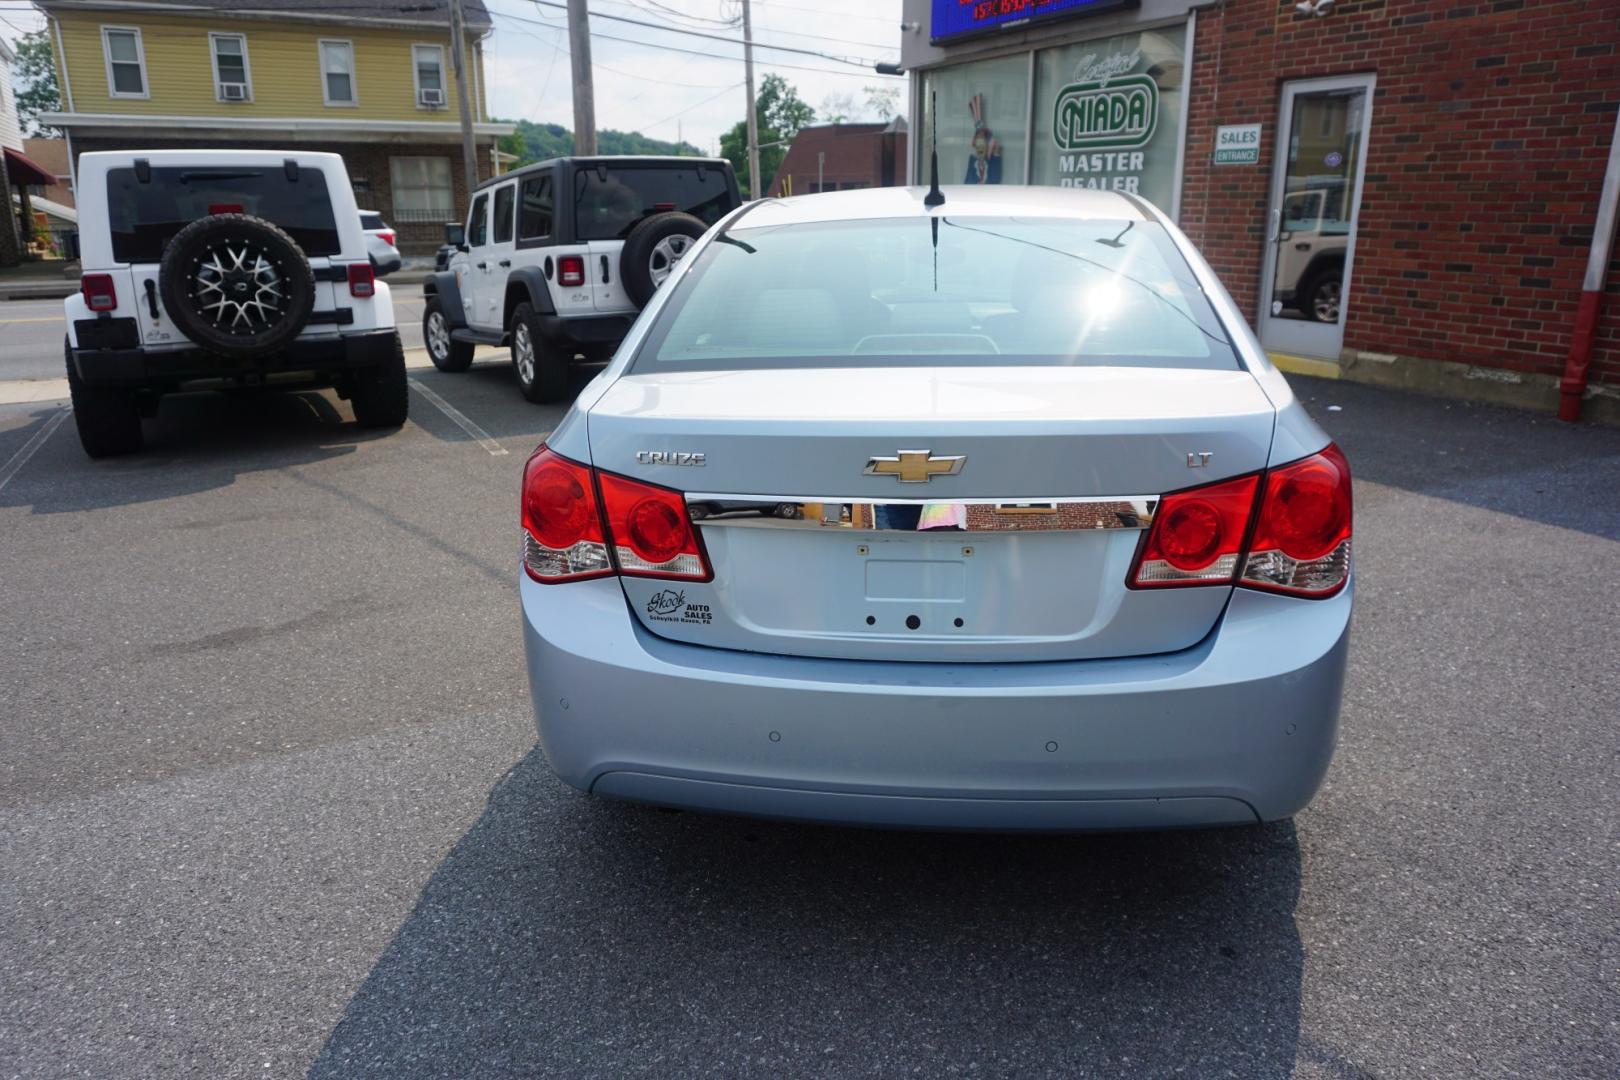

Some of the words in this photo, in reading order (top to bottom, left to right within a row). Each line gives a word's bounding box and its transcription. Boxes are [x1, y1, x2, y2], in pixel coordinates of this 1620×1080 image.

[1061, 89, 1147, 137] NIADA
[1221, 131, 1257, 144] SALES
[1060, 152, 1144, 172] MASTER
[1217, 150, 1257, 161] ENTRANCE
[637, 451, 706, 466] CRUZE
[1187, 451, 1213, 468] LT
[647, 589, 685, 612] Skook
[687, 604, 710, 612] AUTO
